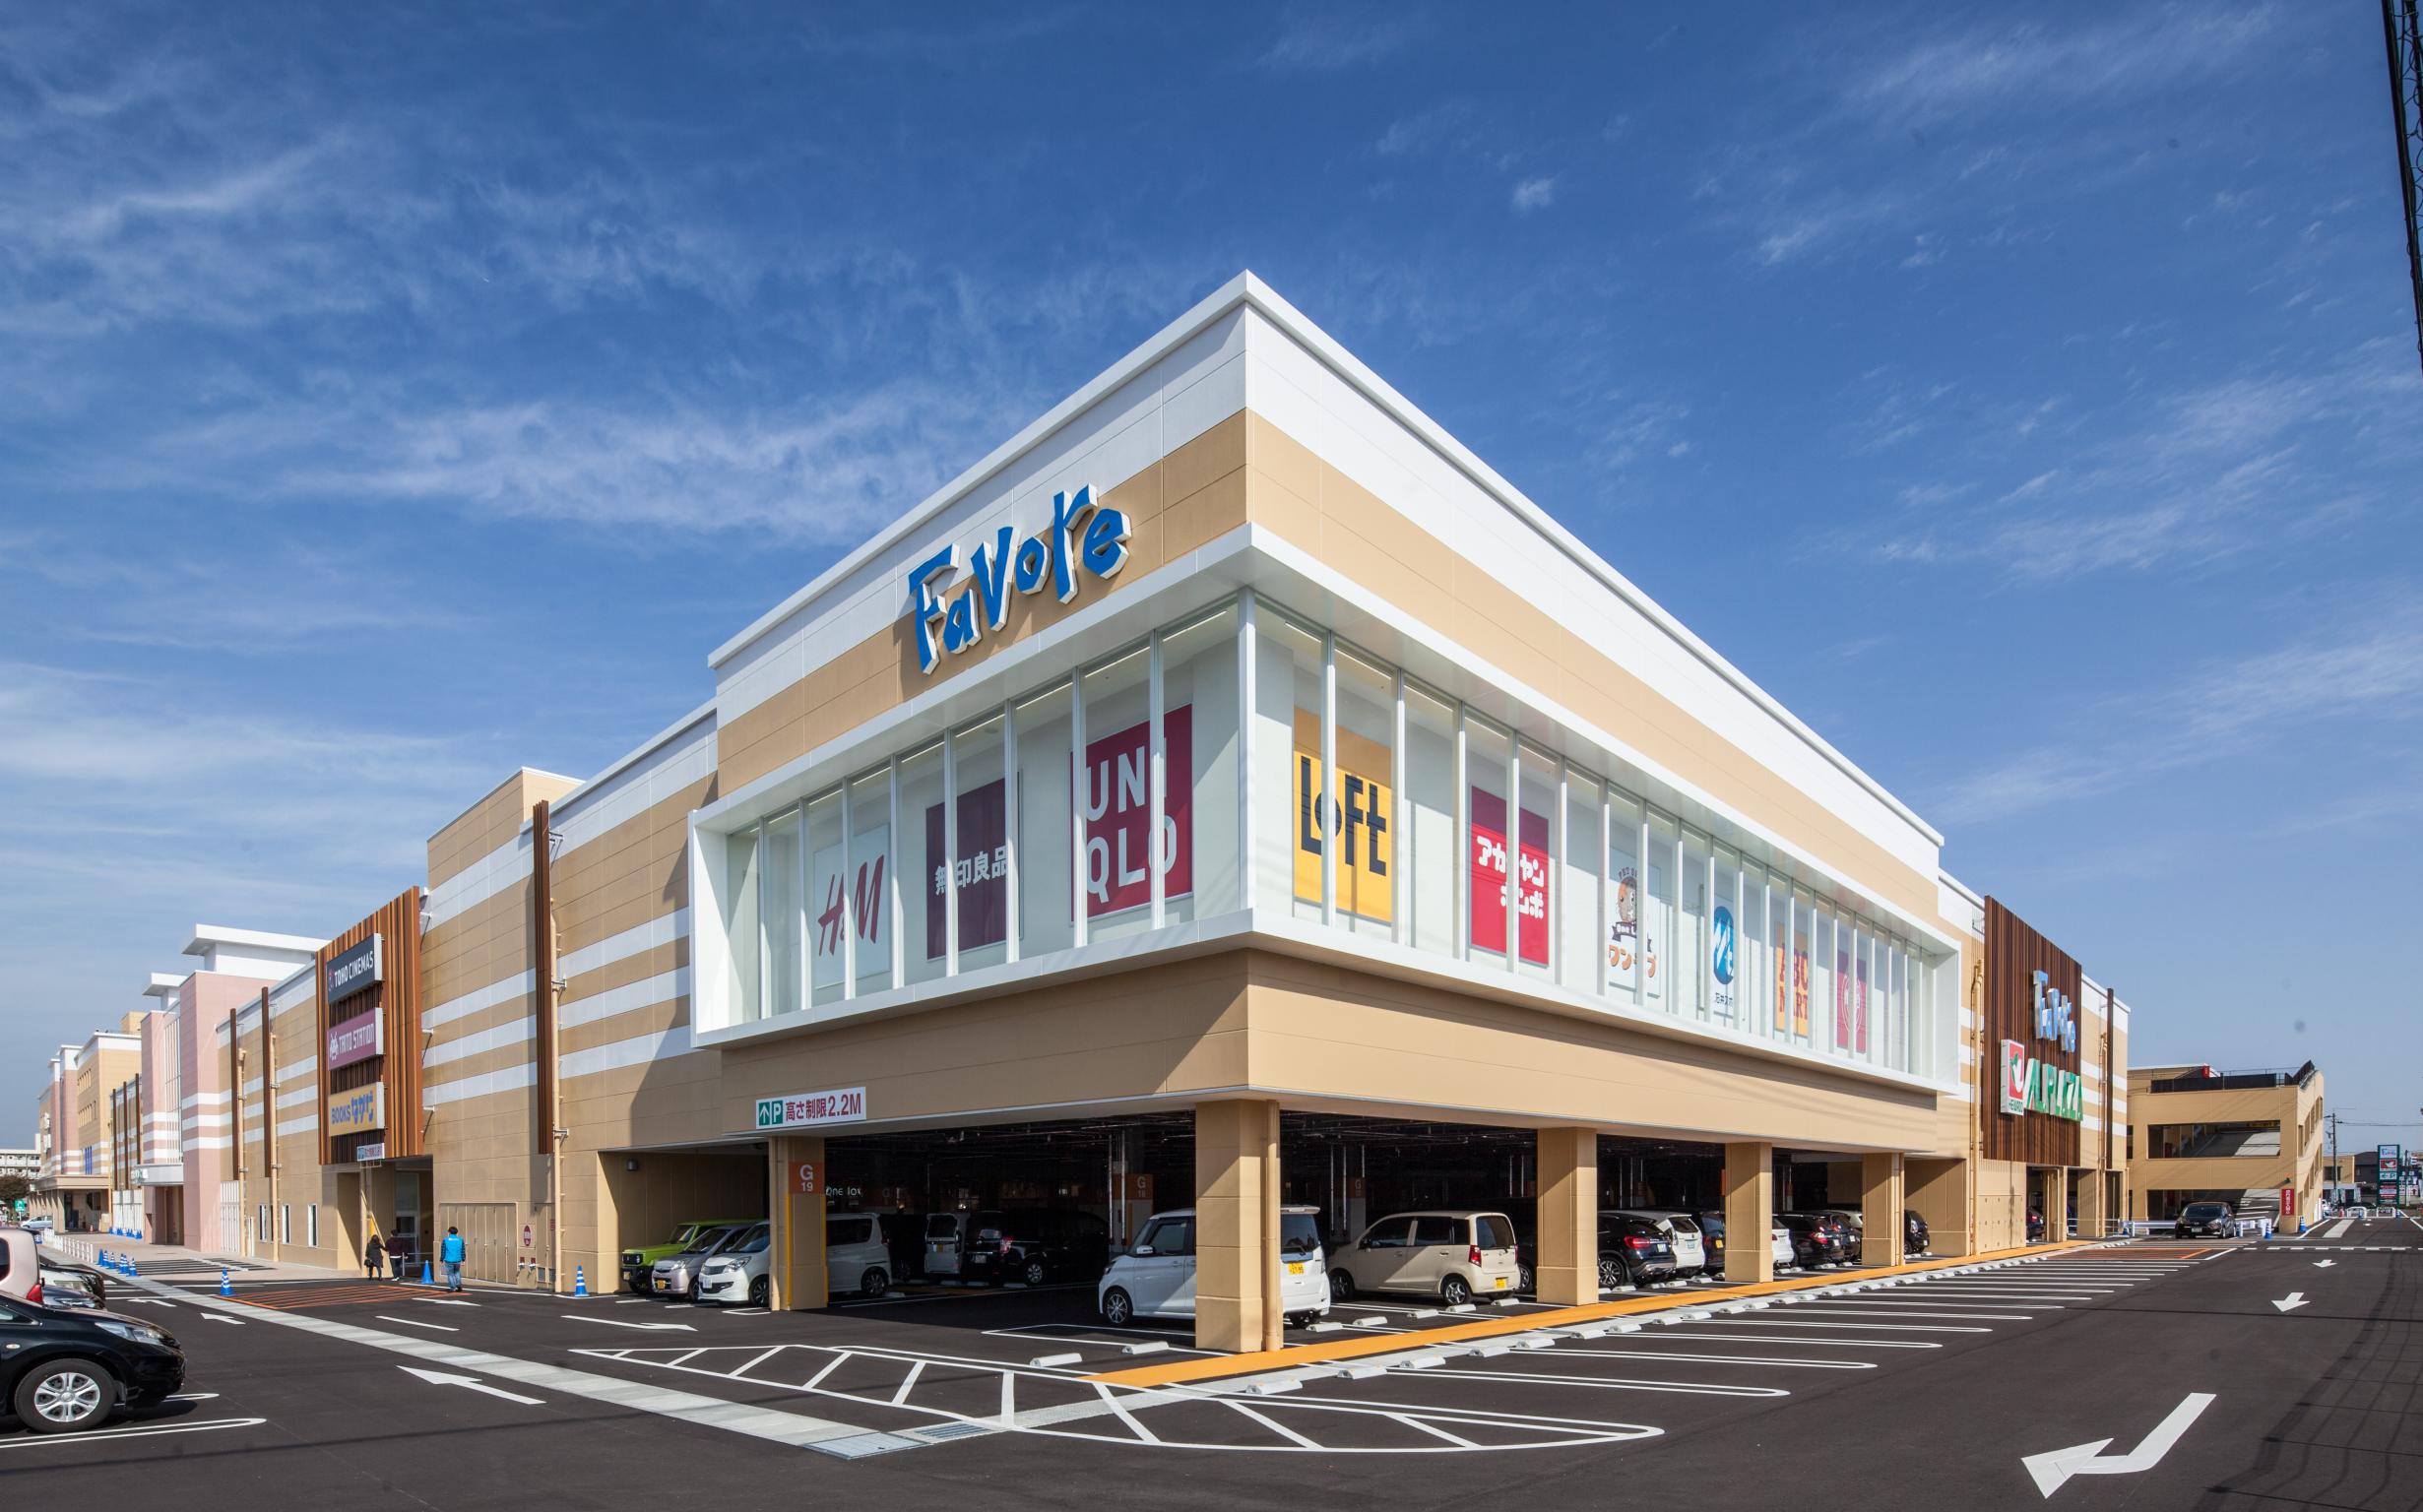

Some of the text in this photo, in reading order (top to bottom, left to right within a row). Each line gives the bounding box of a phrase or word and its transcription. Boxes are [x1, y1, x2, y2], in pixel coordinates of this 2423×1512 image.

[1086, 738, 1168, 822] UN
[1477, 835, 1544, 888] アカャン
[334, 950, 374, 987] TOHO CINEMAS
[353, 1023, 375, 1049] STATION
[773, 1102, 782, 1123] P
[799, 1165, 813, 1181] G
[800, 1181, 813, 1192] 19
